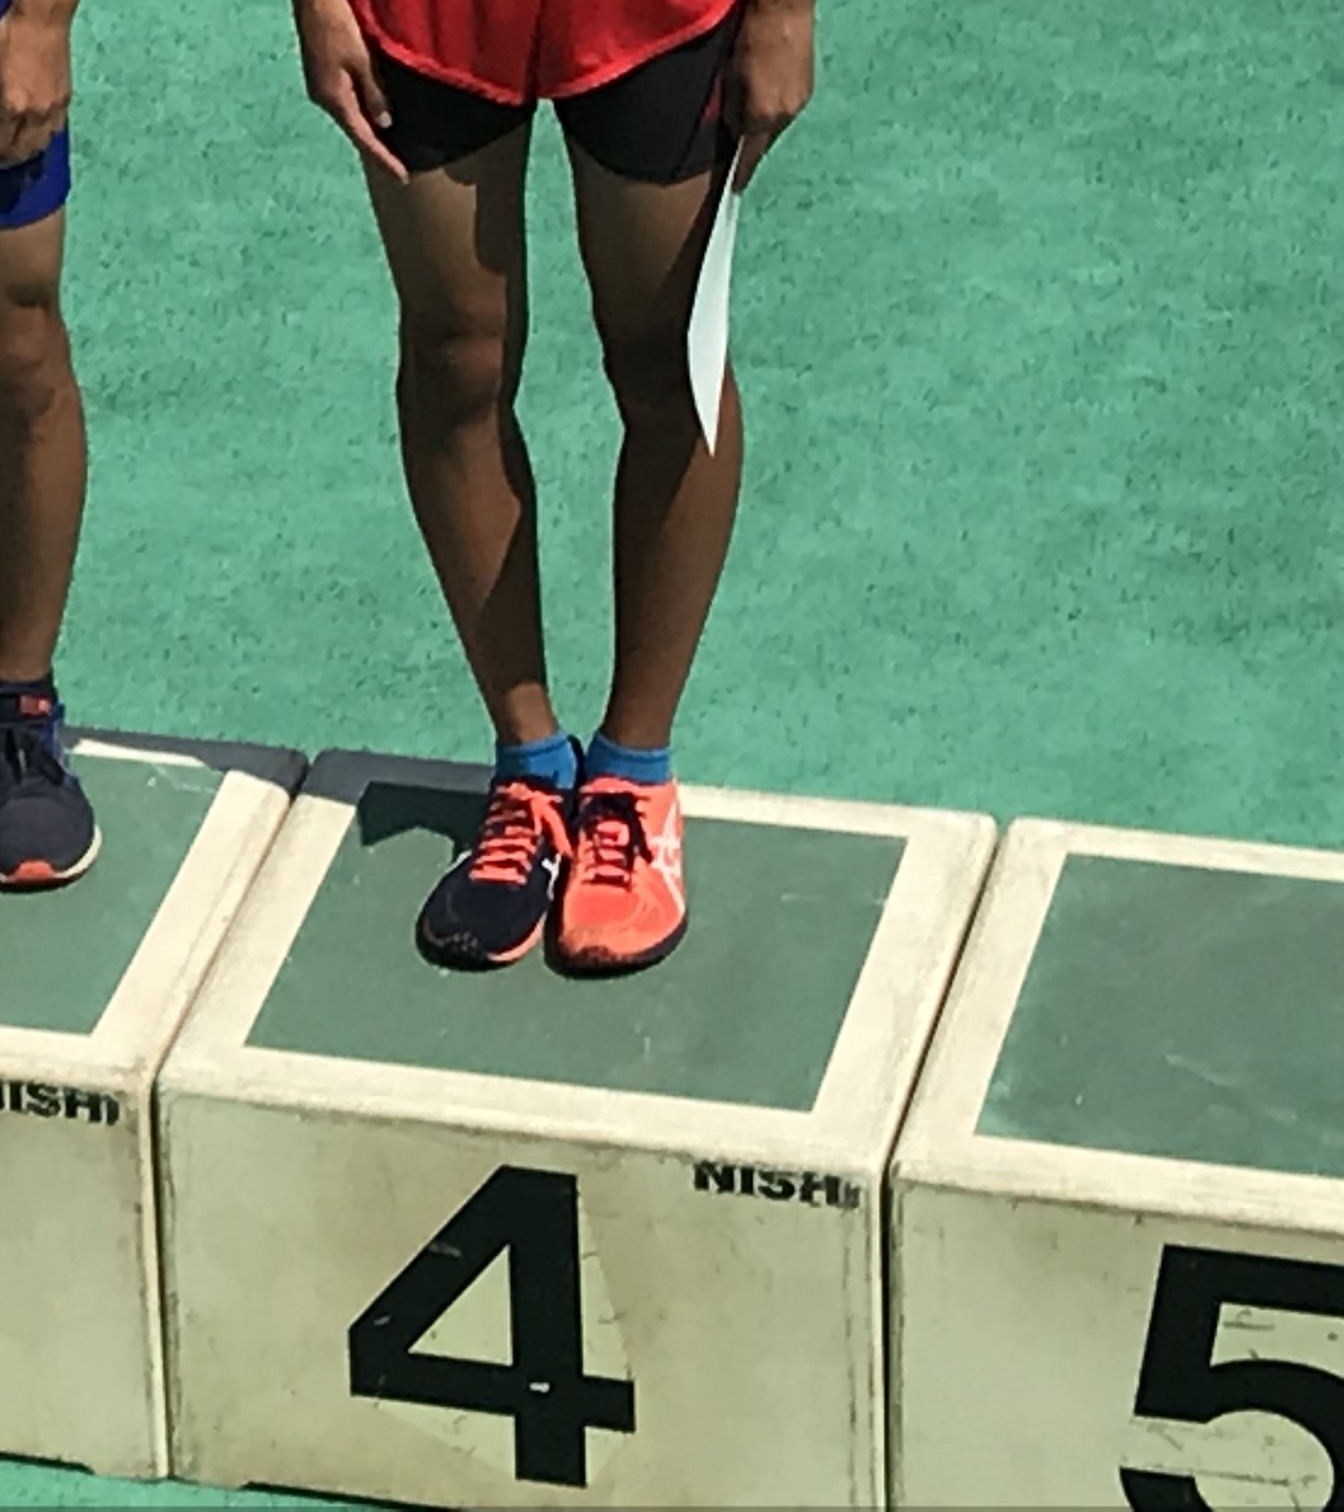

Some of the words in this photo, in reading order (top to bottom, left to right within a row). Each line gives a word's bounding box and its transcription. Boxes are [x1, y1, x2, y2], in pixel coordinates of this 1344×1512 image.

[693, 1159, 861, 1210] NISHI
[347, 1162, 638, 1487] 4
[1119, 1243, 1344, 1512] 5
